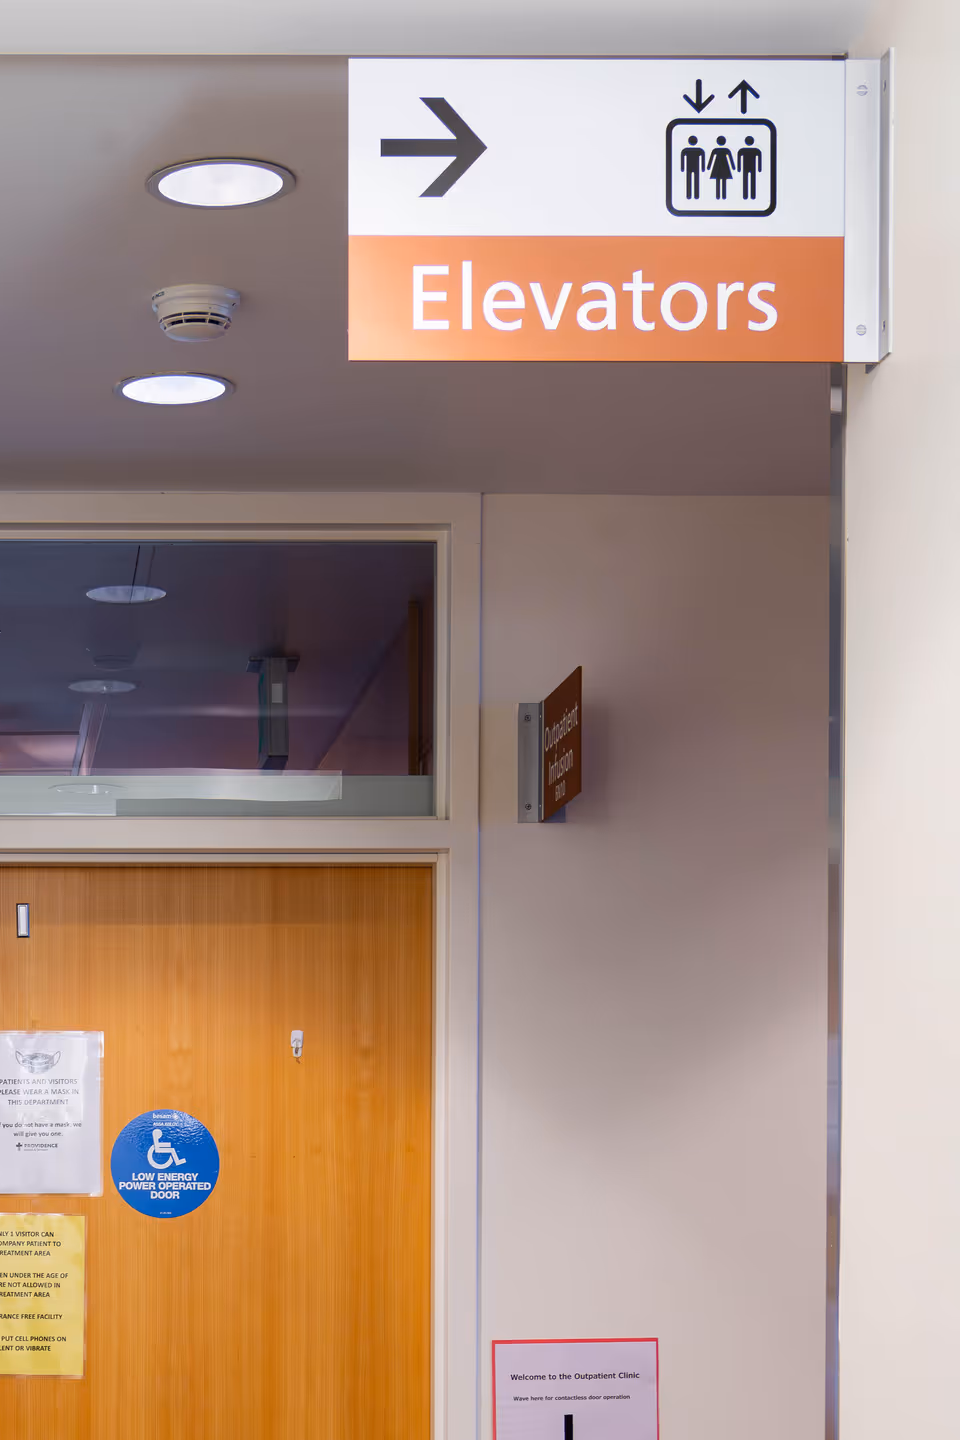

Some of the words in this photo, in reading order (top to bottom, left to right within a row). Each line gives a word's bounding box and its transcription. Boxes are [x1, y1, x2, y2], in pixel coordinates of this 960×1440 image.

[412, 260, 778, 332] Elevators
[545, 704, 579, 752] Outpatient
[548, 747, 574, 785] Infusion
[132, 1173, 155, 1181] LOW
[158, 1173, 198, 1181] ENERGY
[158, 1182, 211, 1190] OPERATED
[574, 1373, 616, 1381] Outpatient
